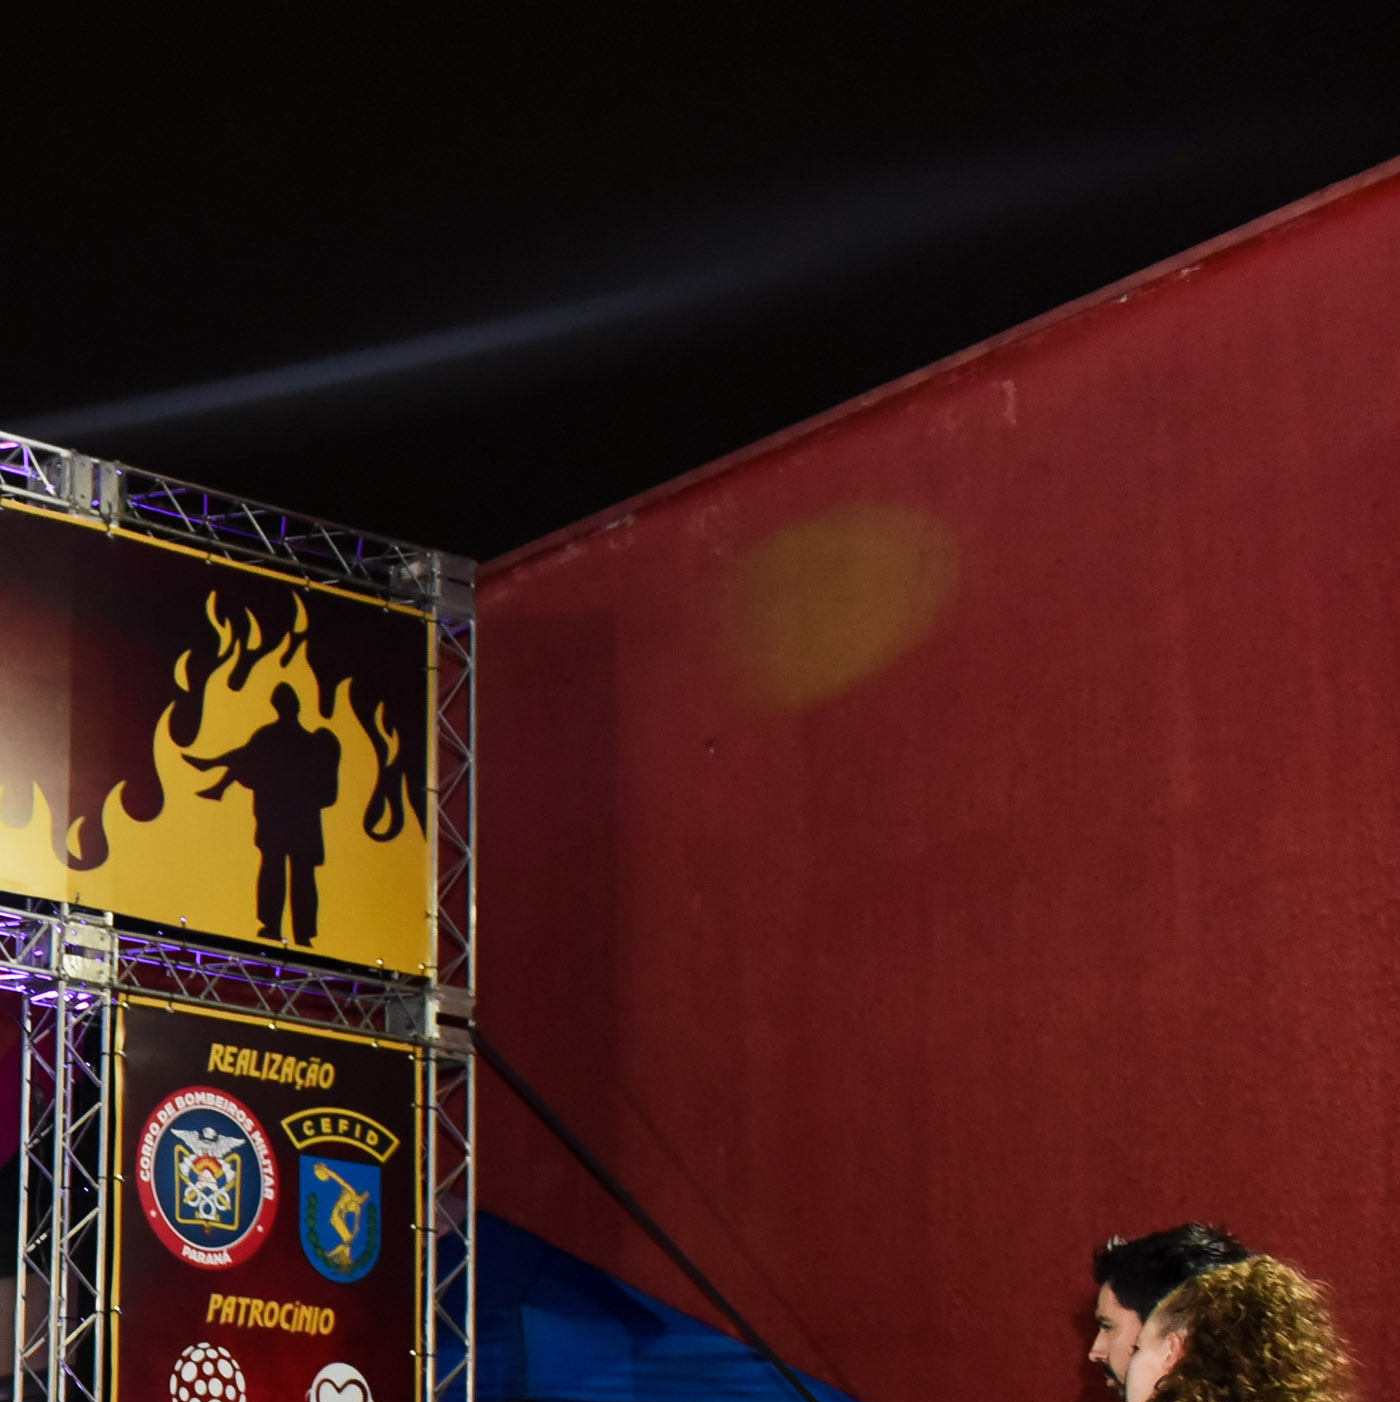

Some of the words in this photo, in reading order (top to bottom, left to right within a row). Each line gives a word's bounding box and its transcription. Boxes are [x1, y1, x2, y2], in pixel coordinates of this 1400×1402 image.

[207, 1042, 336, 1090] REALIZAÇÃO
[139, 1121, 159, 1183] CORPO
[174, 1091, 255, 1133] BOMBEIROS
[251, 1129, 275, 1200] MILITAR
[302, 1118, 380, 1146] CEFID
[181, 1244, 232, 1266] PARANÁ
[206, 1293, 335, 1336] PATROCÍNIO
